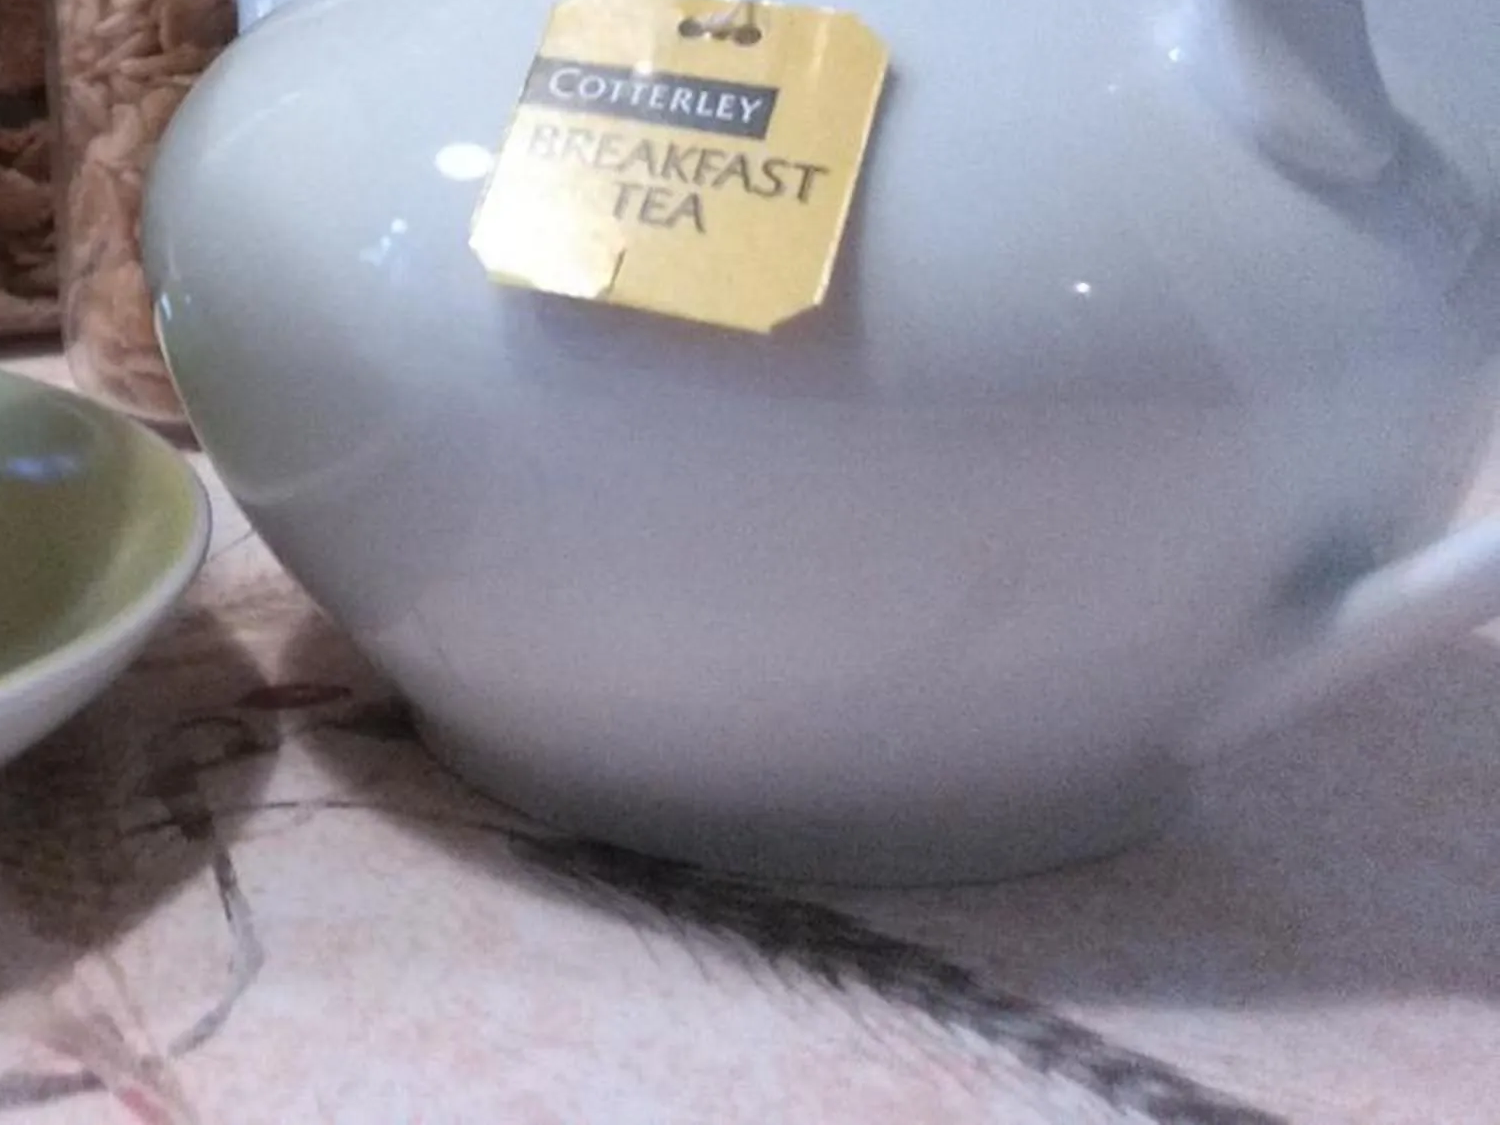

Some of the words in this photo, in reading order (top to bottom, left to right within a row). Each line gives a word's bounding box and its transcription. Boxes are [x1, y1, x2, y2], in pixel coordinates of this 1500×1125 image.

[549, 67, 762, 124] COTTERLEY
[529, 125, 830, 203] BREAKFAST
[612, 183, 706, 233] TEA
